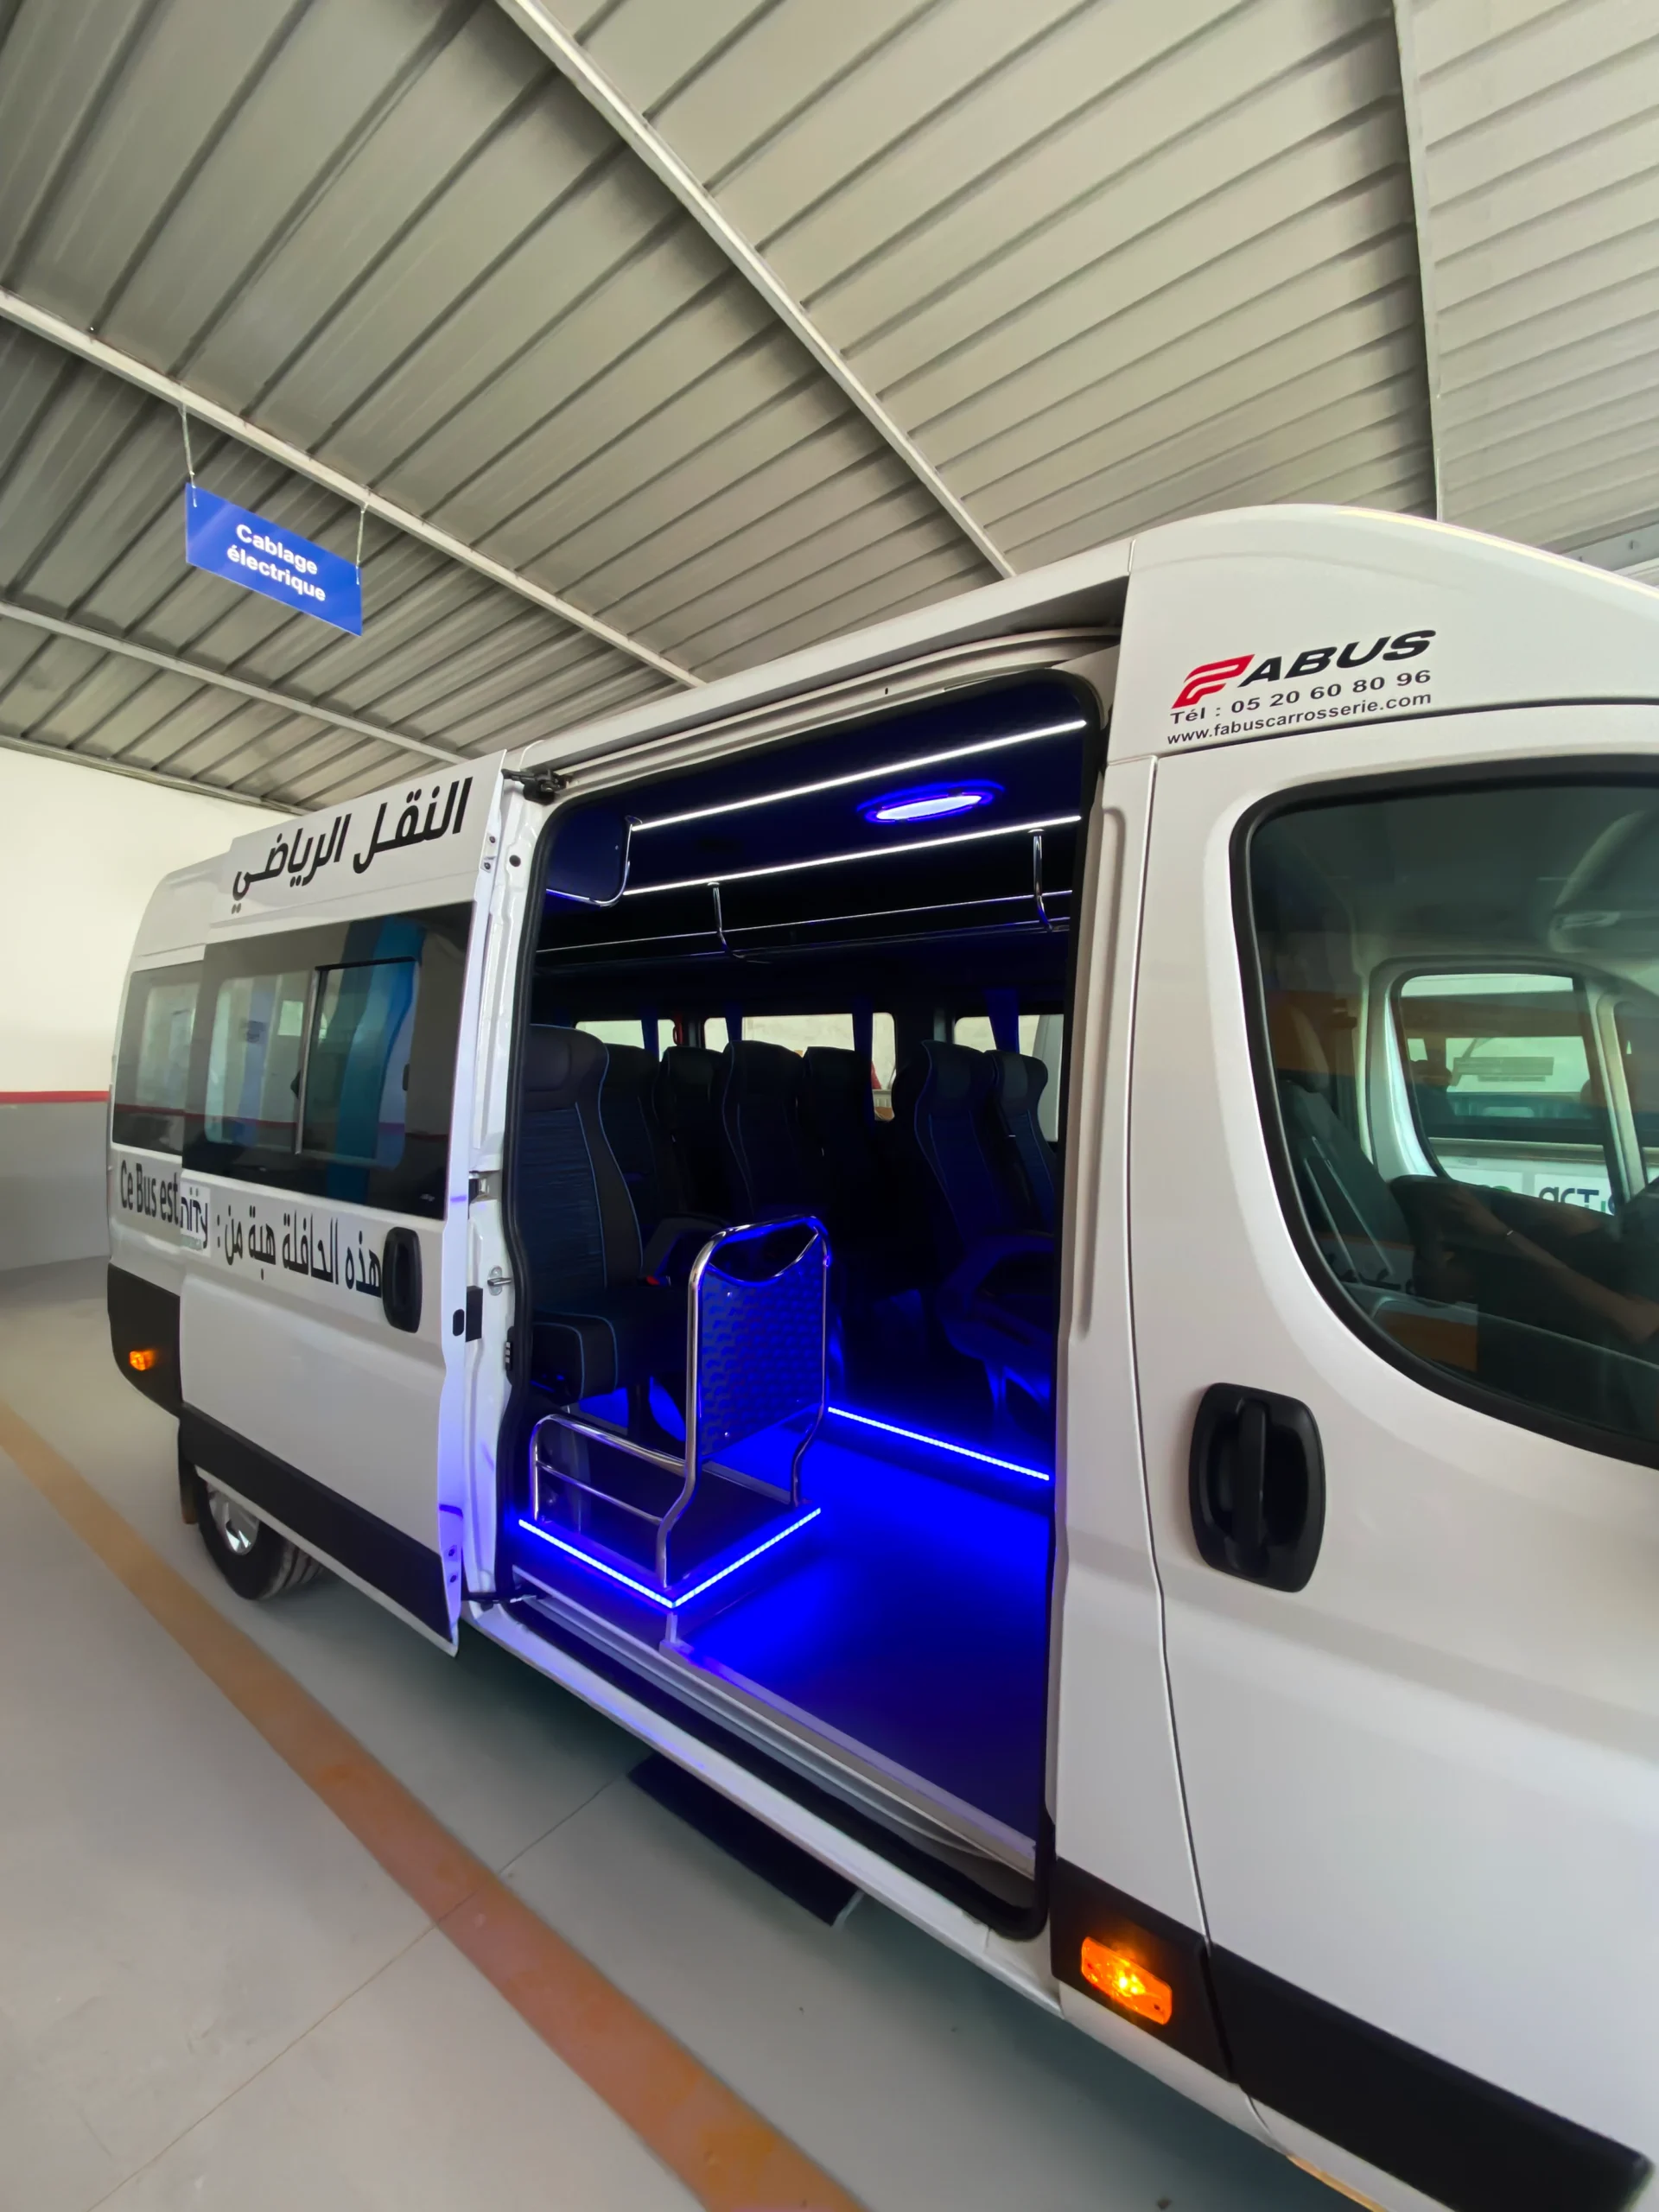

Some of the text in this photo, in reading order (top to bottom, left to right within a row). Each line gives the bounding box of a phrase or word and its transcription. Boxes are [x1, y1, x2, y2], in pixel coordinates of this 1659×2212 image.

[226, 544, 326, 601] électrique
[236, 524, 318, 575] Cablage
[1170, 707, 1206, 724] Tél
[1231, 696, 1261, 714] 05
[1269, 690, 1300, 708] 20
[1310, 683, 1342, 700] 60
[1352, 677, 1385, 693] 80
[1396, 669, 1431, 687] 96
[1172, 630, 1436, 709] FABUS
[1167, 693, 1432, 745] www.fabuscarrosserie.com
[231, 776, 474, 915] النقل الرياضي
[121, 1160, 179, 1226] Ce Bus est
[225, 1205, 243, 1266] من
[248, 1205, 276, 1281] هبة
[282, 1210, 340, 1286] الحافلة
[346, 1230, 382, 1299] هذه
